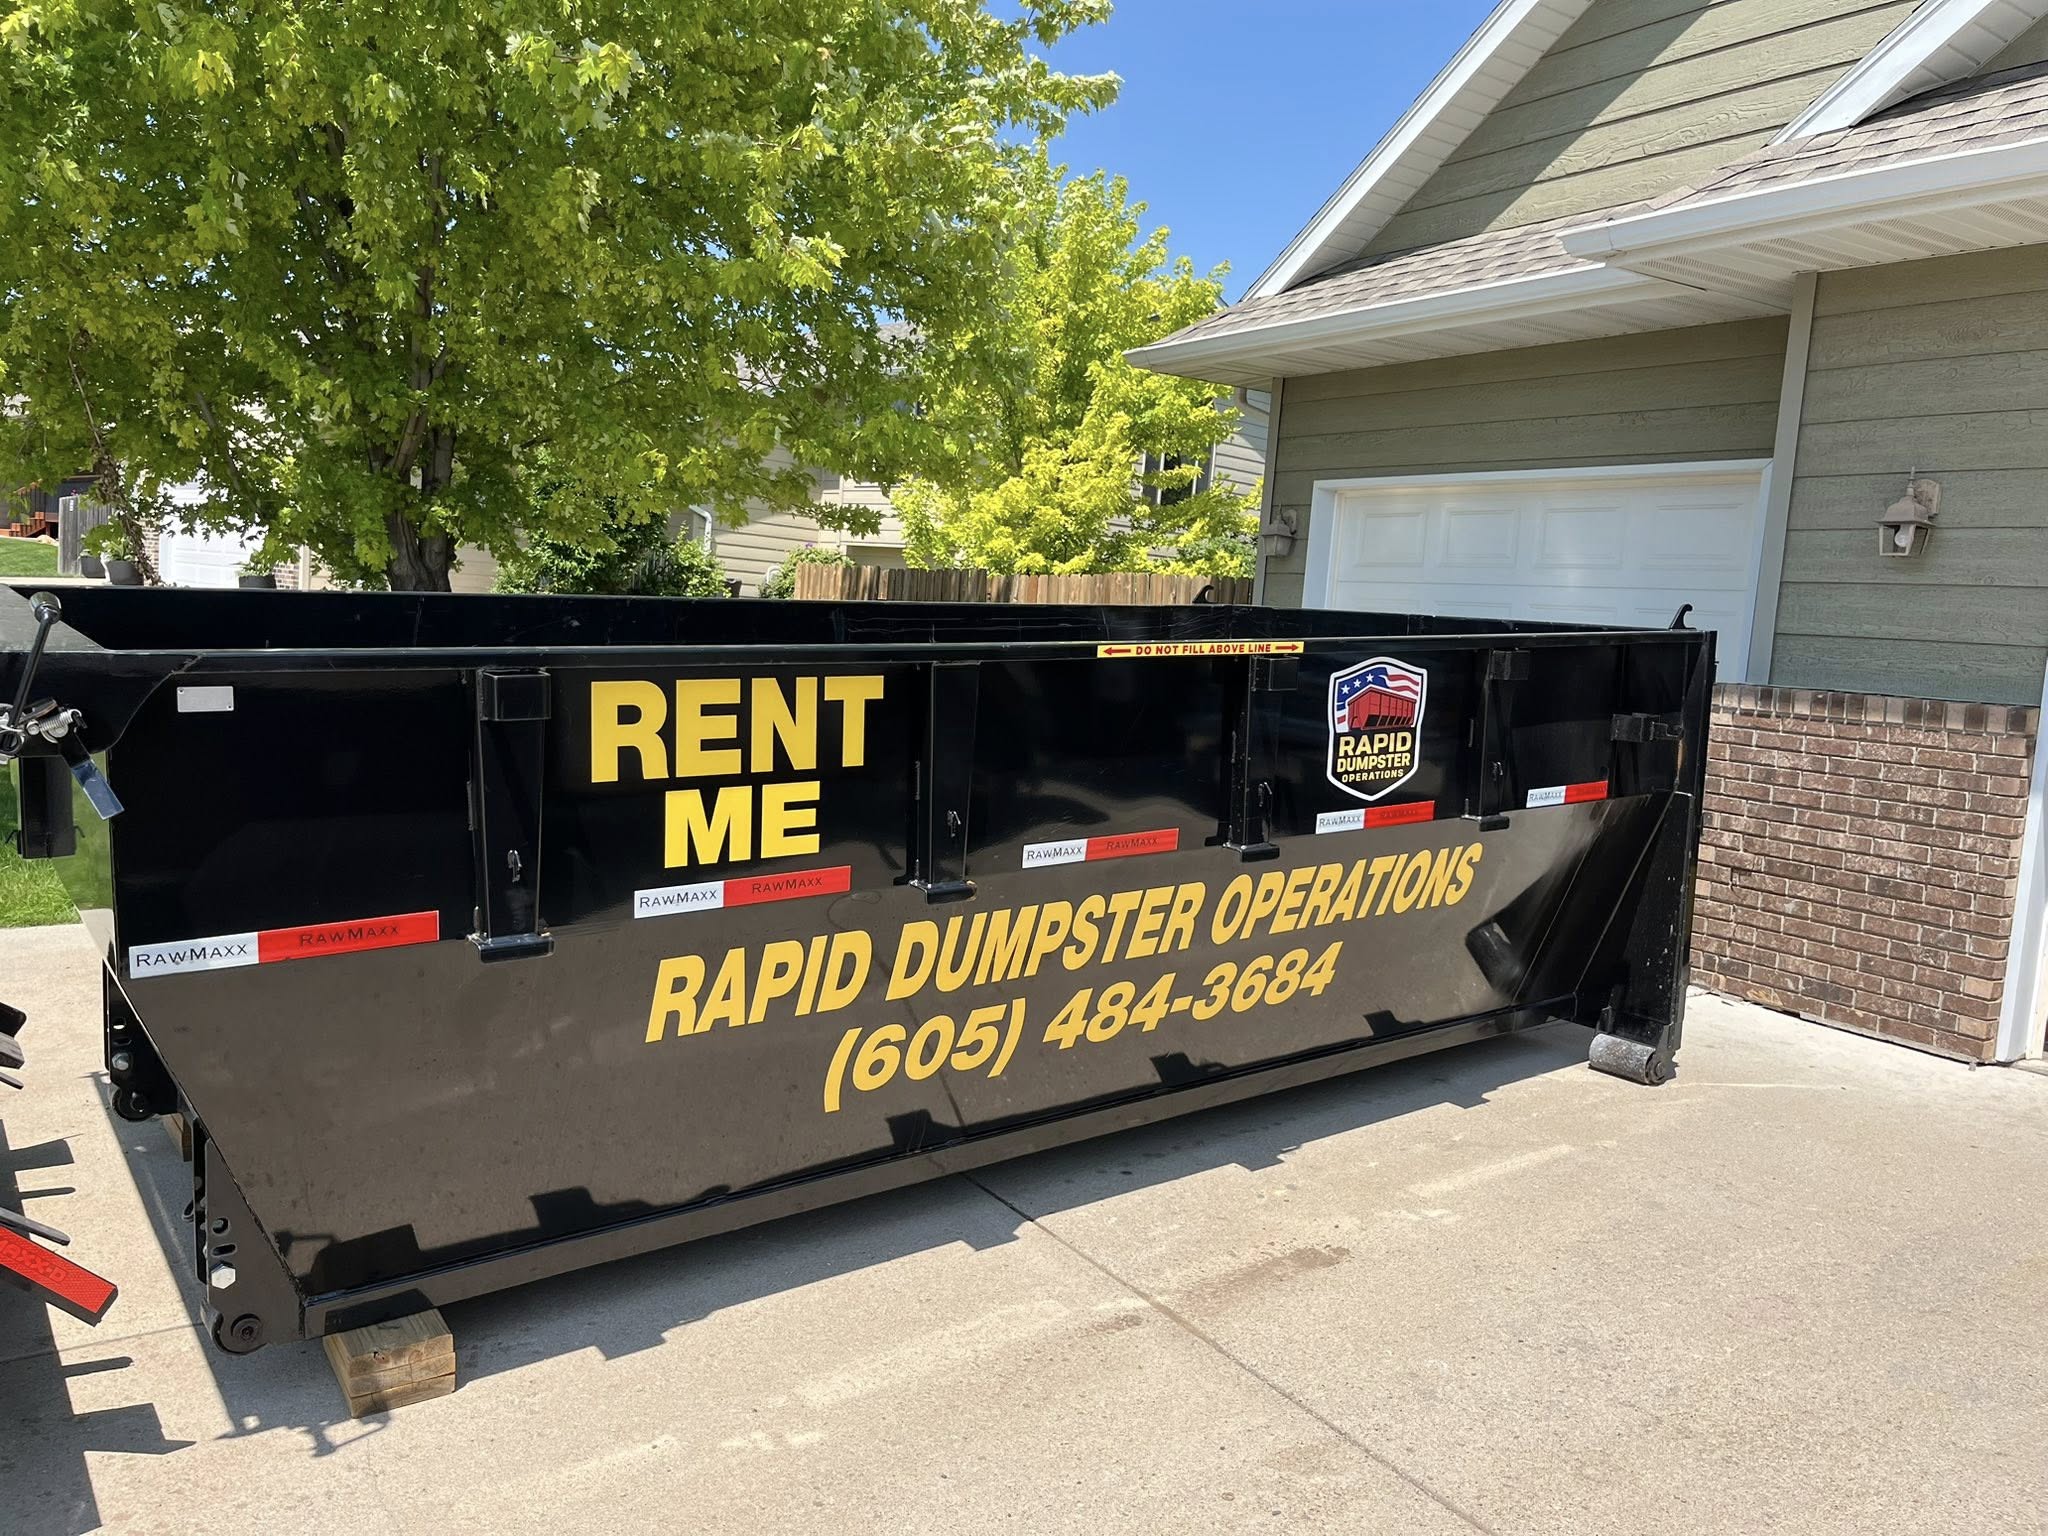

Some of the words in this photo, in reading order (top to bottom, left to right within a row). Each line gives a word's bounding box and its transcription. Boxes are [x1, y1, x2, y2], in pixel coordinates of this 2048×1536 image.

[1135, 645, 1152, 655] DO
[1155, 645, 1178, 655] NOT
[1182, 644, 1205, 654] FILL
[1208, 644, 1245, 653] ABOVE
[1248, 643, 1272, 653] LINE
[591, 675, 884, 783] RENT
[1338, 731, 1412, 757] RAPID
[1336, 752, 1411, 773] DUMPSTER
[1341, 769, 1404, 783] OPERATIONS
[664, 781, 820, 868] ME
[645, 929, 872, 1044] RAPID
[885, 881, 1206, 1001] DUMPSTER
[1211, 841, 1483, 946] OPERATIONS
[823, 997, 1027, 1113] (605)
[1042, 941, 1344, 1050] 484-3684
